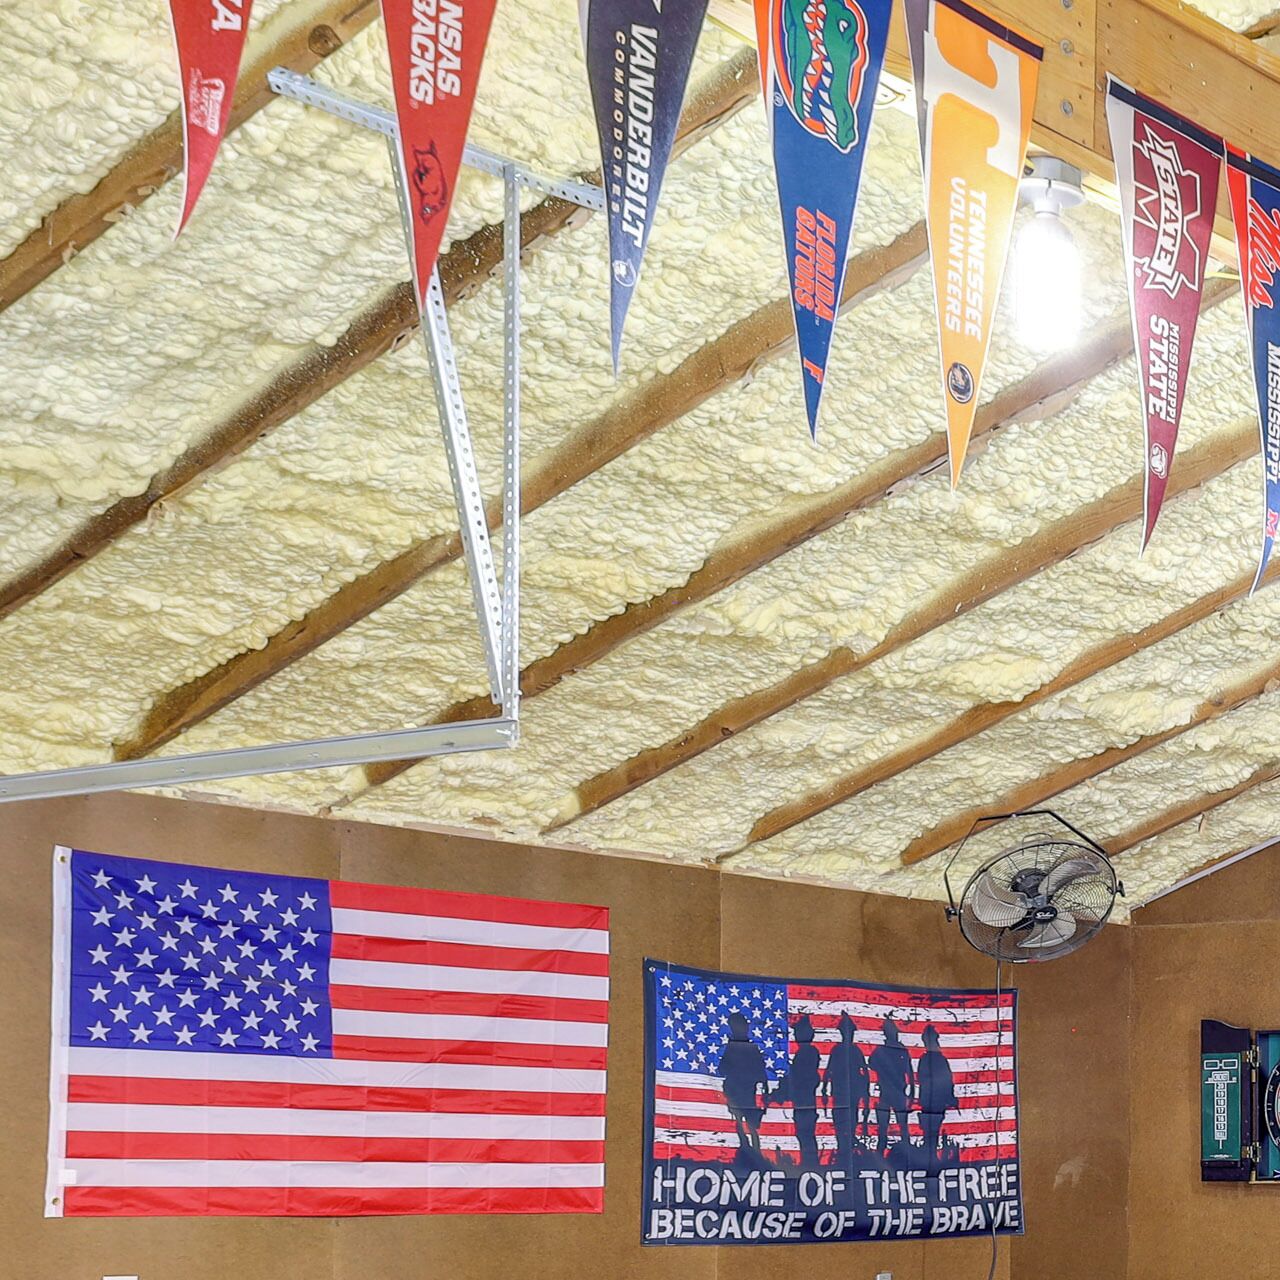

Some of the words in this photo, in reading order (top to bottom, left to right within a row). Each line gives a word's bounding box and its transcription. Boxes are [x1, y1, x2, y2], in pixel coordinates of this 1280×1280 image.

[611, 29, 626, 215] COMMODORES
[622, 22, 658, 249] VANDERBILT
[794, 205, 818, 312] GATORS
[813, 208, 837, 323] FLORIDA
[944, 176, 968, 335] VOLUNTEERS
[963, 188, 988, 344] TENNESSEE
[1154, 164, 1181, 267] STATE
[802, 356, 824, 386] F
[1148, 314, 1170, 422] STATE
[1166, 321, 1181, 425] MISSISSIPPI
[648, 1207, 806, 1241] BECAUSE
[812, 1210, 856, 1239] OF
[866, 1207, 926, 1238] THE
[929, 1199, 1021, 1235] BRAVE
[652, 1165, 786, 1208] HOME
[798, 1169, 846, 1208] OF
[858, 1168, 927, 1205] THE
[936, 1163, 1019, 1202] FREE
